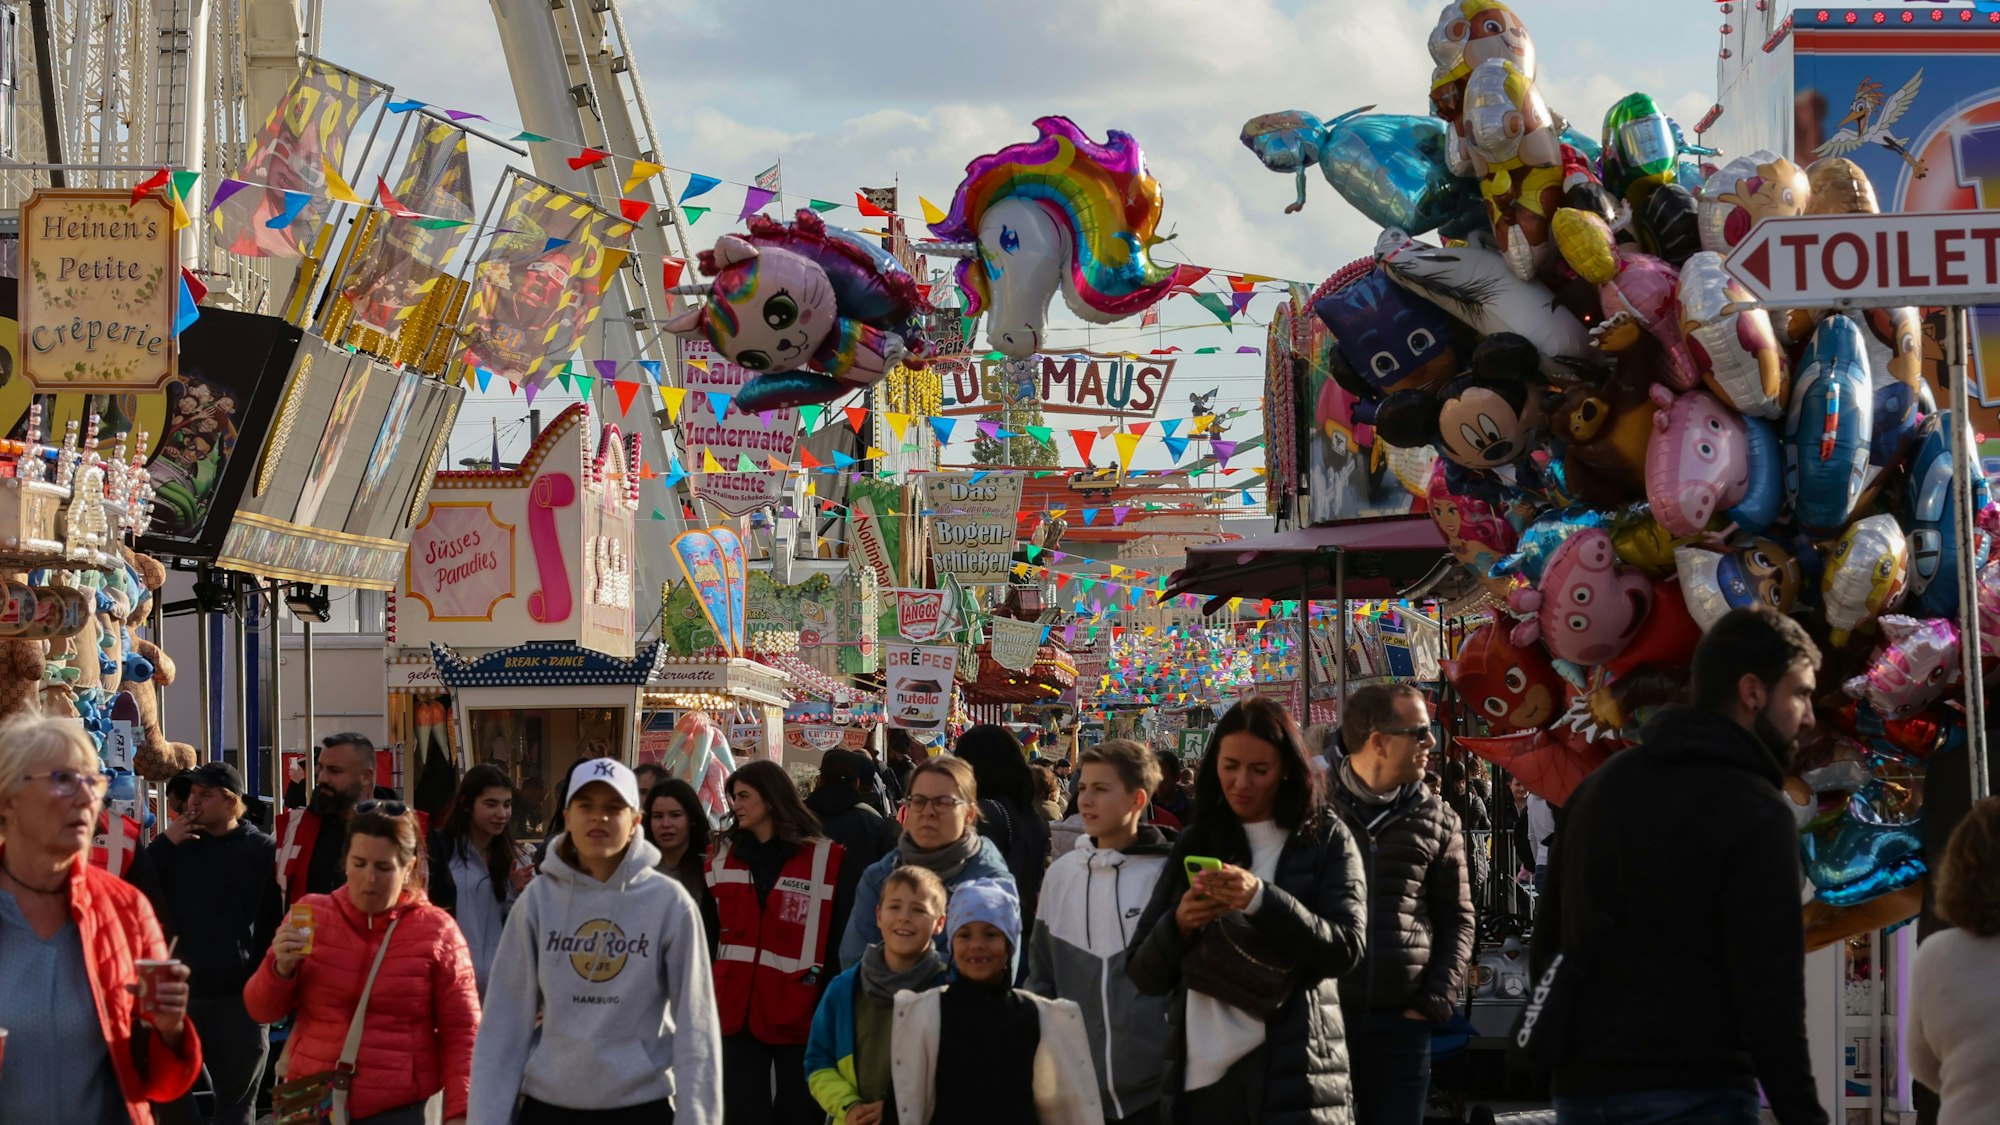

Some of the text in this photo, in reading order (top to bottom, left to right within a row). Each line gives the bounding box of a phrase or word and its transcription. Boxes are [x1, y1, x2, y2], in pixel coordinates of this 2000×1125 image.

[58, 256, 142, 281] Petite
[1780, 227, 2000, 292] TOILET
[32, 317, 162, 353] Crêperie
[1041, 356, 1163, 411] MAUS
[685, 421, 795, 455] Zuckerwatte
[706, 472, 766, 494] Früchte
[950, 482, 998, 502] Das
[425, 530, 481, 564] Süsses
[936, 521, 1012, 548] Bogen-
[433, 551, 497, 593] Paradies
[933, 549, 1010, 576] schießen
[1382, 635, 1393, 643] VIP
[504, 655, 585, 668] BREAK DANCE
[888, 646, 953, 671] CRÊPES
[897, 692, 939, 705] nutella
[546, 930, 649, 958] Hard Rock
